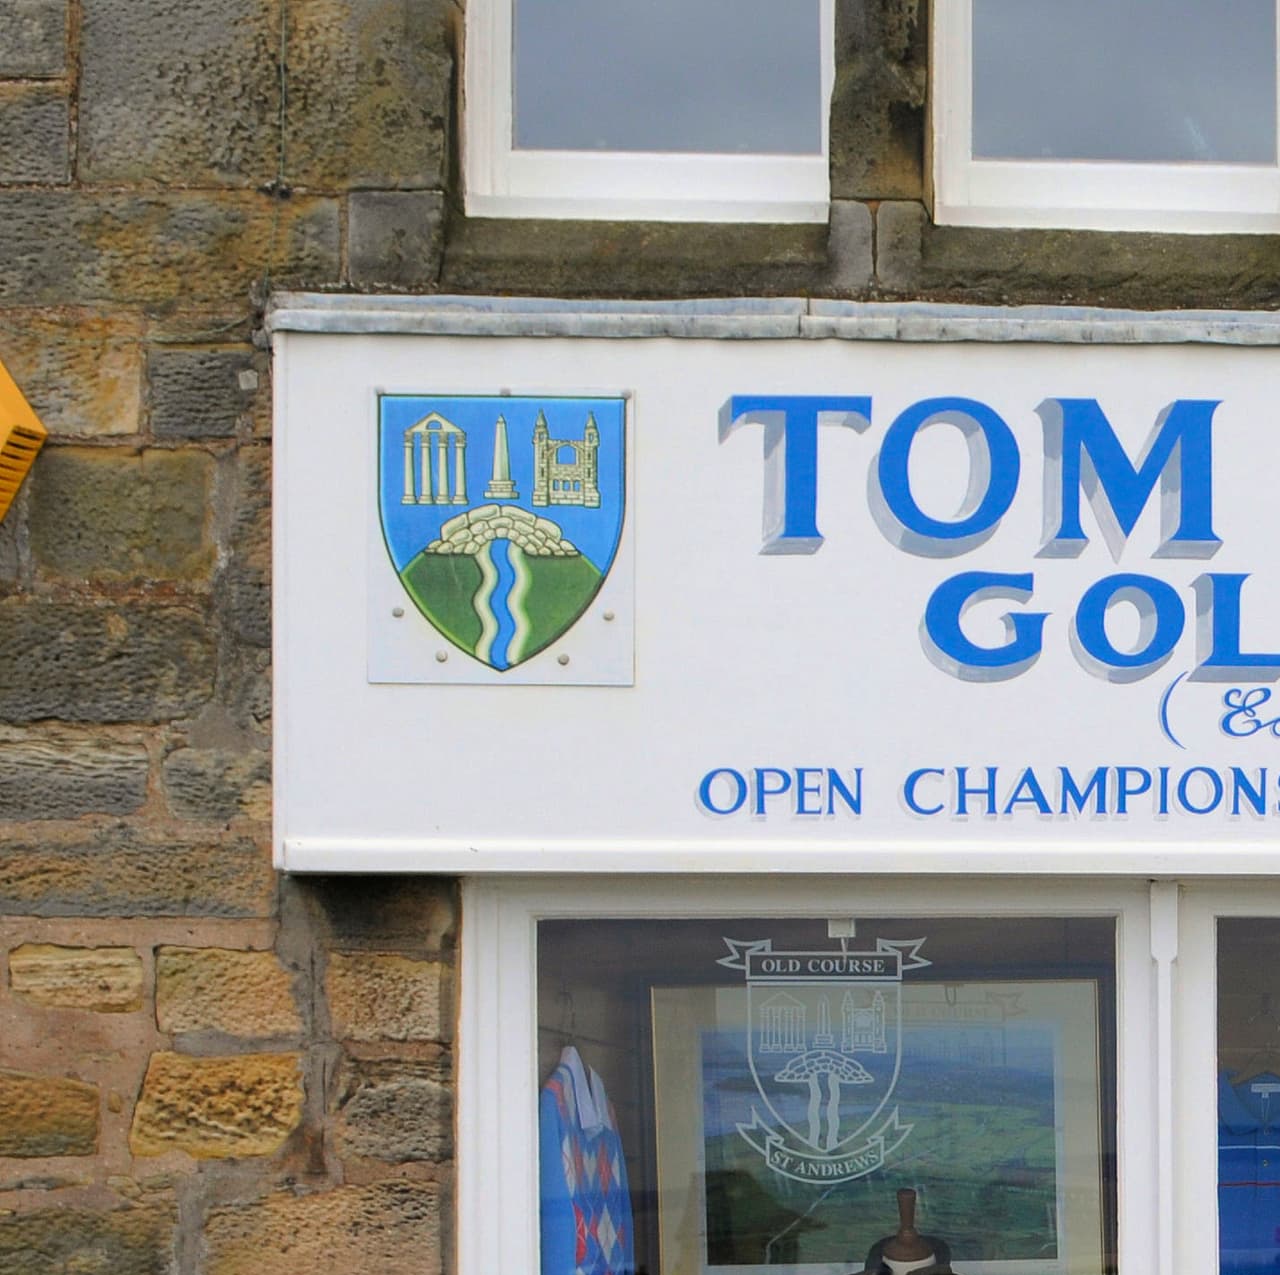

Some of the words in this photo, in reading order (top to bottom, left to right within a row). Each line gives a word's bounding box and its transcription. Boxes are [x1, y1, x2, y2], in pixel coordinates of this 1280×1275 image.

[726, 393, 1222, 544] TOM
[698, 767, 863, 815] OPEN
[761, 958, 800, 973] OLD
[807, 957, 885, 973] COURSE
[771, 1150, 793, 1169] ST
[794, 1150, 879, 1176] ANDREWS
